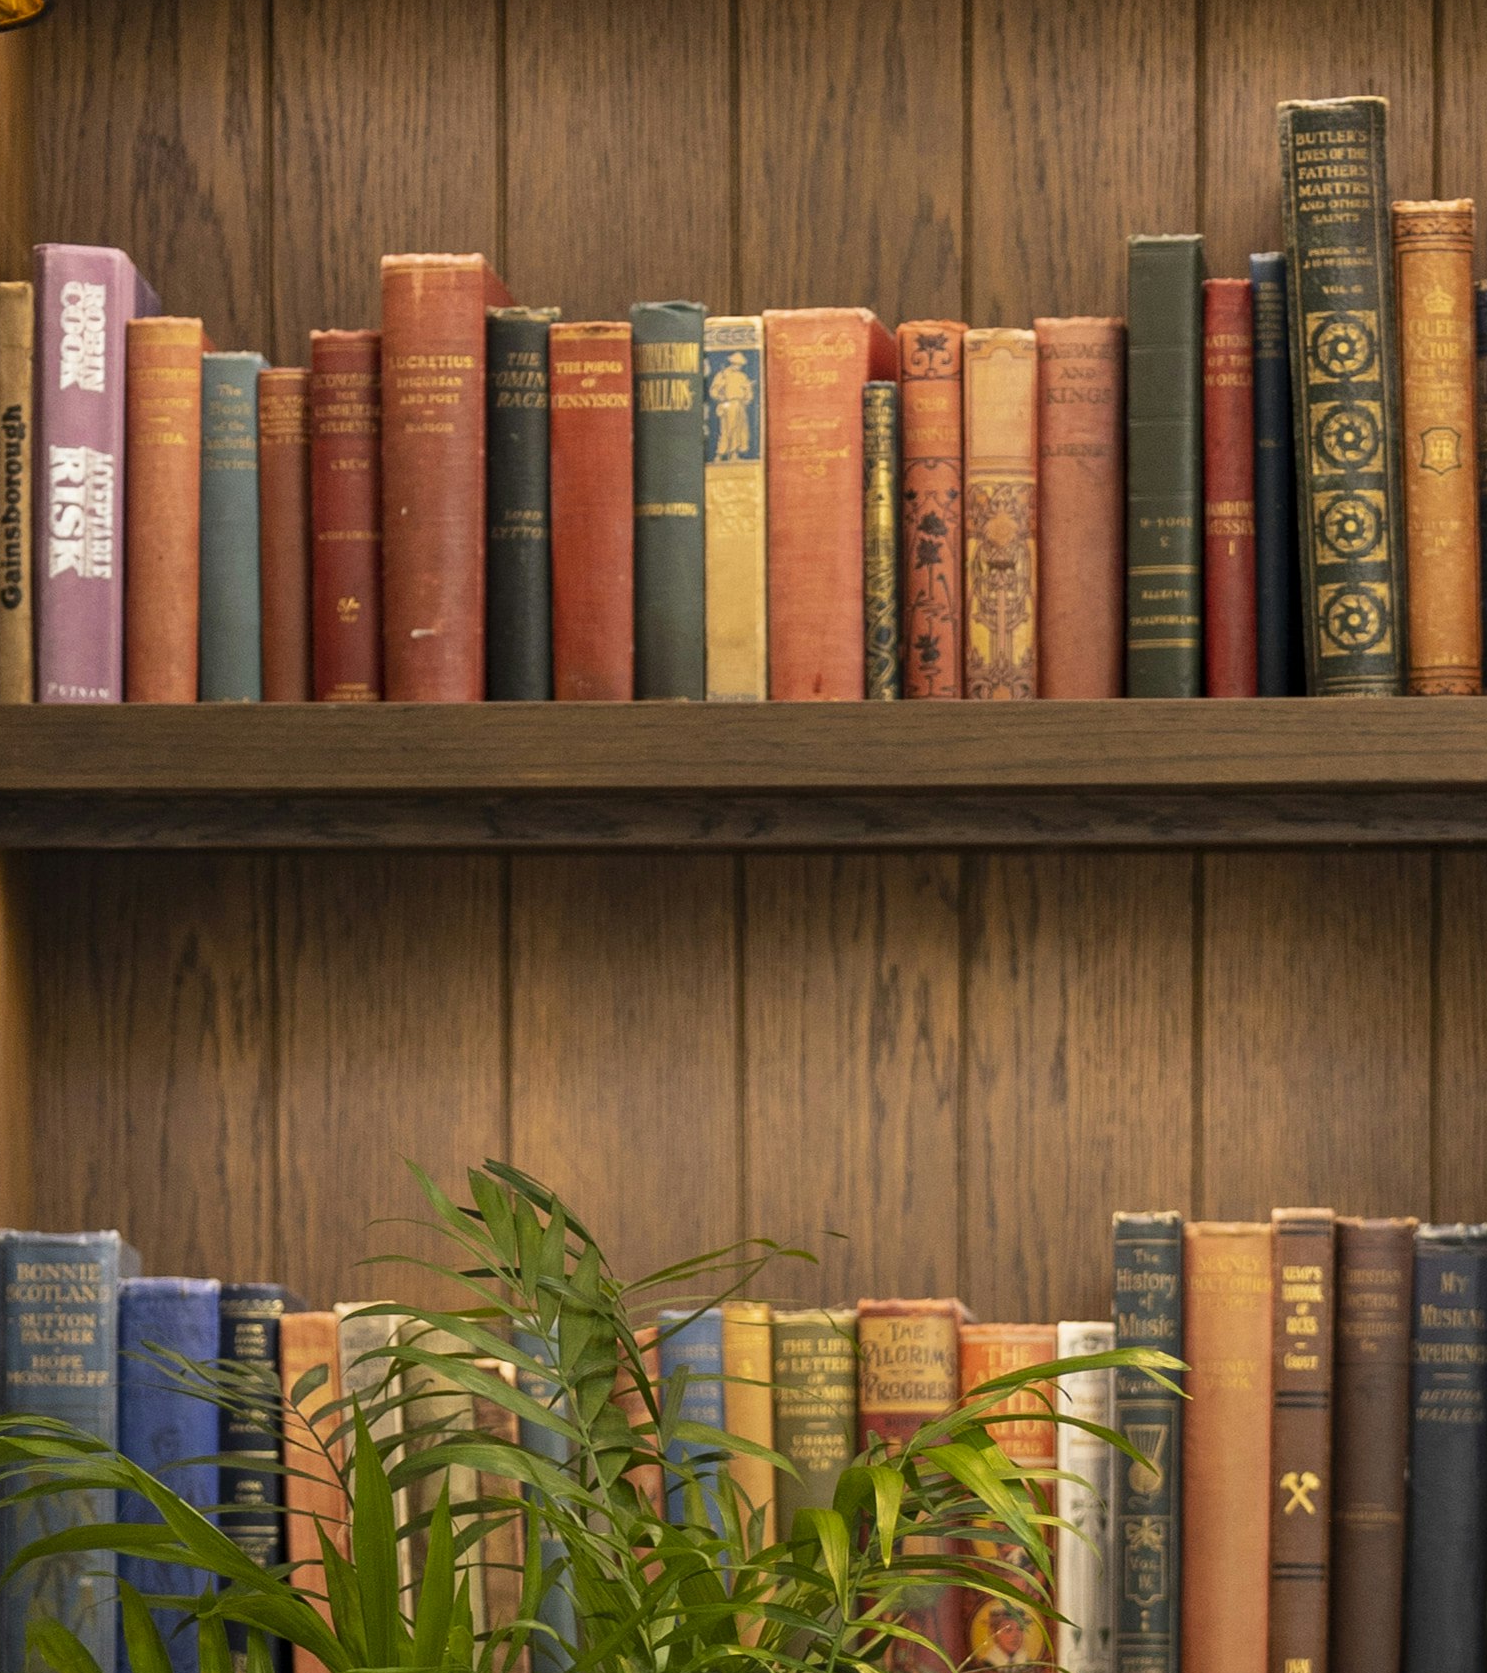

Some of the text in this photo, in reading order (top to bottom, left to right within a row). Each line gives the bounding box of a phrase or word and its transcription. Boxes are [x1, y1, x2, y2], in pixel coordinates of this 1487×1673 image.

[1294, 130, 1368, 146] BUTLER'S
[1295, 148, 1368, 163] LIVES OF THE
[1298, 164, 1368, 180] FATHERS
[1299, 181, 1371, 197] MARTYRS
[1300, 200, 1327, 212] AND
[1312, 212, 1361, 225] SAINTS
[59, 280, 86, 390] COOK
[83, 282, 106, 392] ROBIN
[389, 355, 475, 369] LUCRETIUS
[507, 352, 542, 367] THE
[555, 361, 624, 374] THE POEMS
[1059, 363, 1096, 379] AND
[579, 377, 598, 389] OF
[639, 379, 693, 411] BALLADS
[1046, 387, 1113, 405] KINGS
[0, 403, 25, 610] Gainsborough
[48, 444, 85, 579] RISK
[46, 682, 111, 700] PUTNAM
[1132, 1248, 1160, 1264] The
[16, 1262, 102, 1282] BONNIE
[1115, 1267, 1177, 1300] History
[1439, 1270, 1469, 1295] MY
[5, 1283, 111, 1304] SCOTLAND
[1138, 1293, 1155, 1311] of
[19, 1312, 97, 1329] SUTTON
[1419, 1303, 1487, 1329] MUSICAL
[886, 1321, 925, 1341] THE
[1118, 1311, 1176, 1340] Music
[21, 1329, 95, 1345] PALMER
[780, 1339, 813, 1354] THE
[984, 1343, 1033, 1367] THE
[31, 1354, 84, 1369] HOPE
[857, 1340, 954, 1378] PILGRIM'S
[6, 1370, 110, 1387] MONCRIEFF
[857, 1372, 957, 1403] PROGRESS
